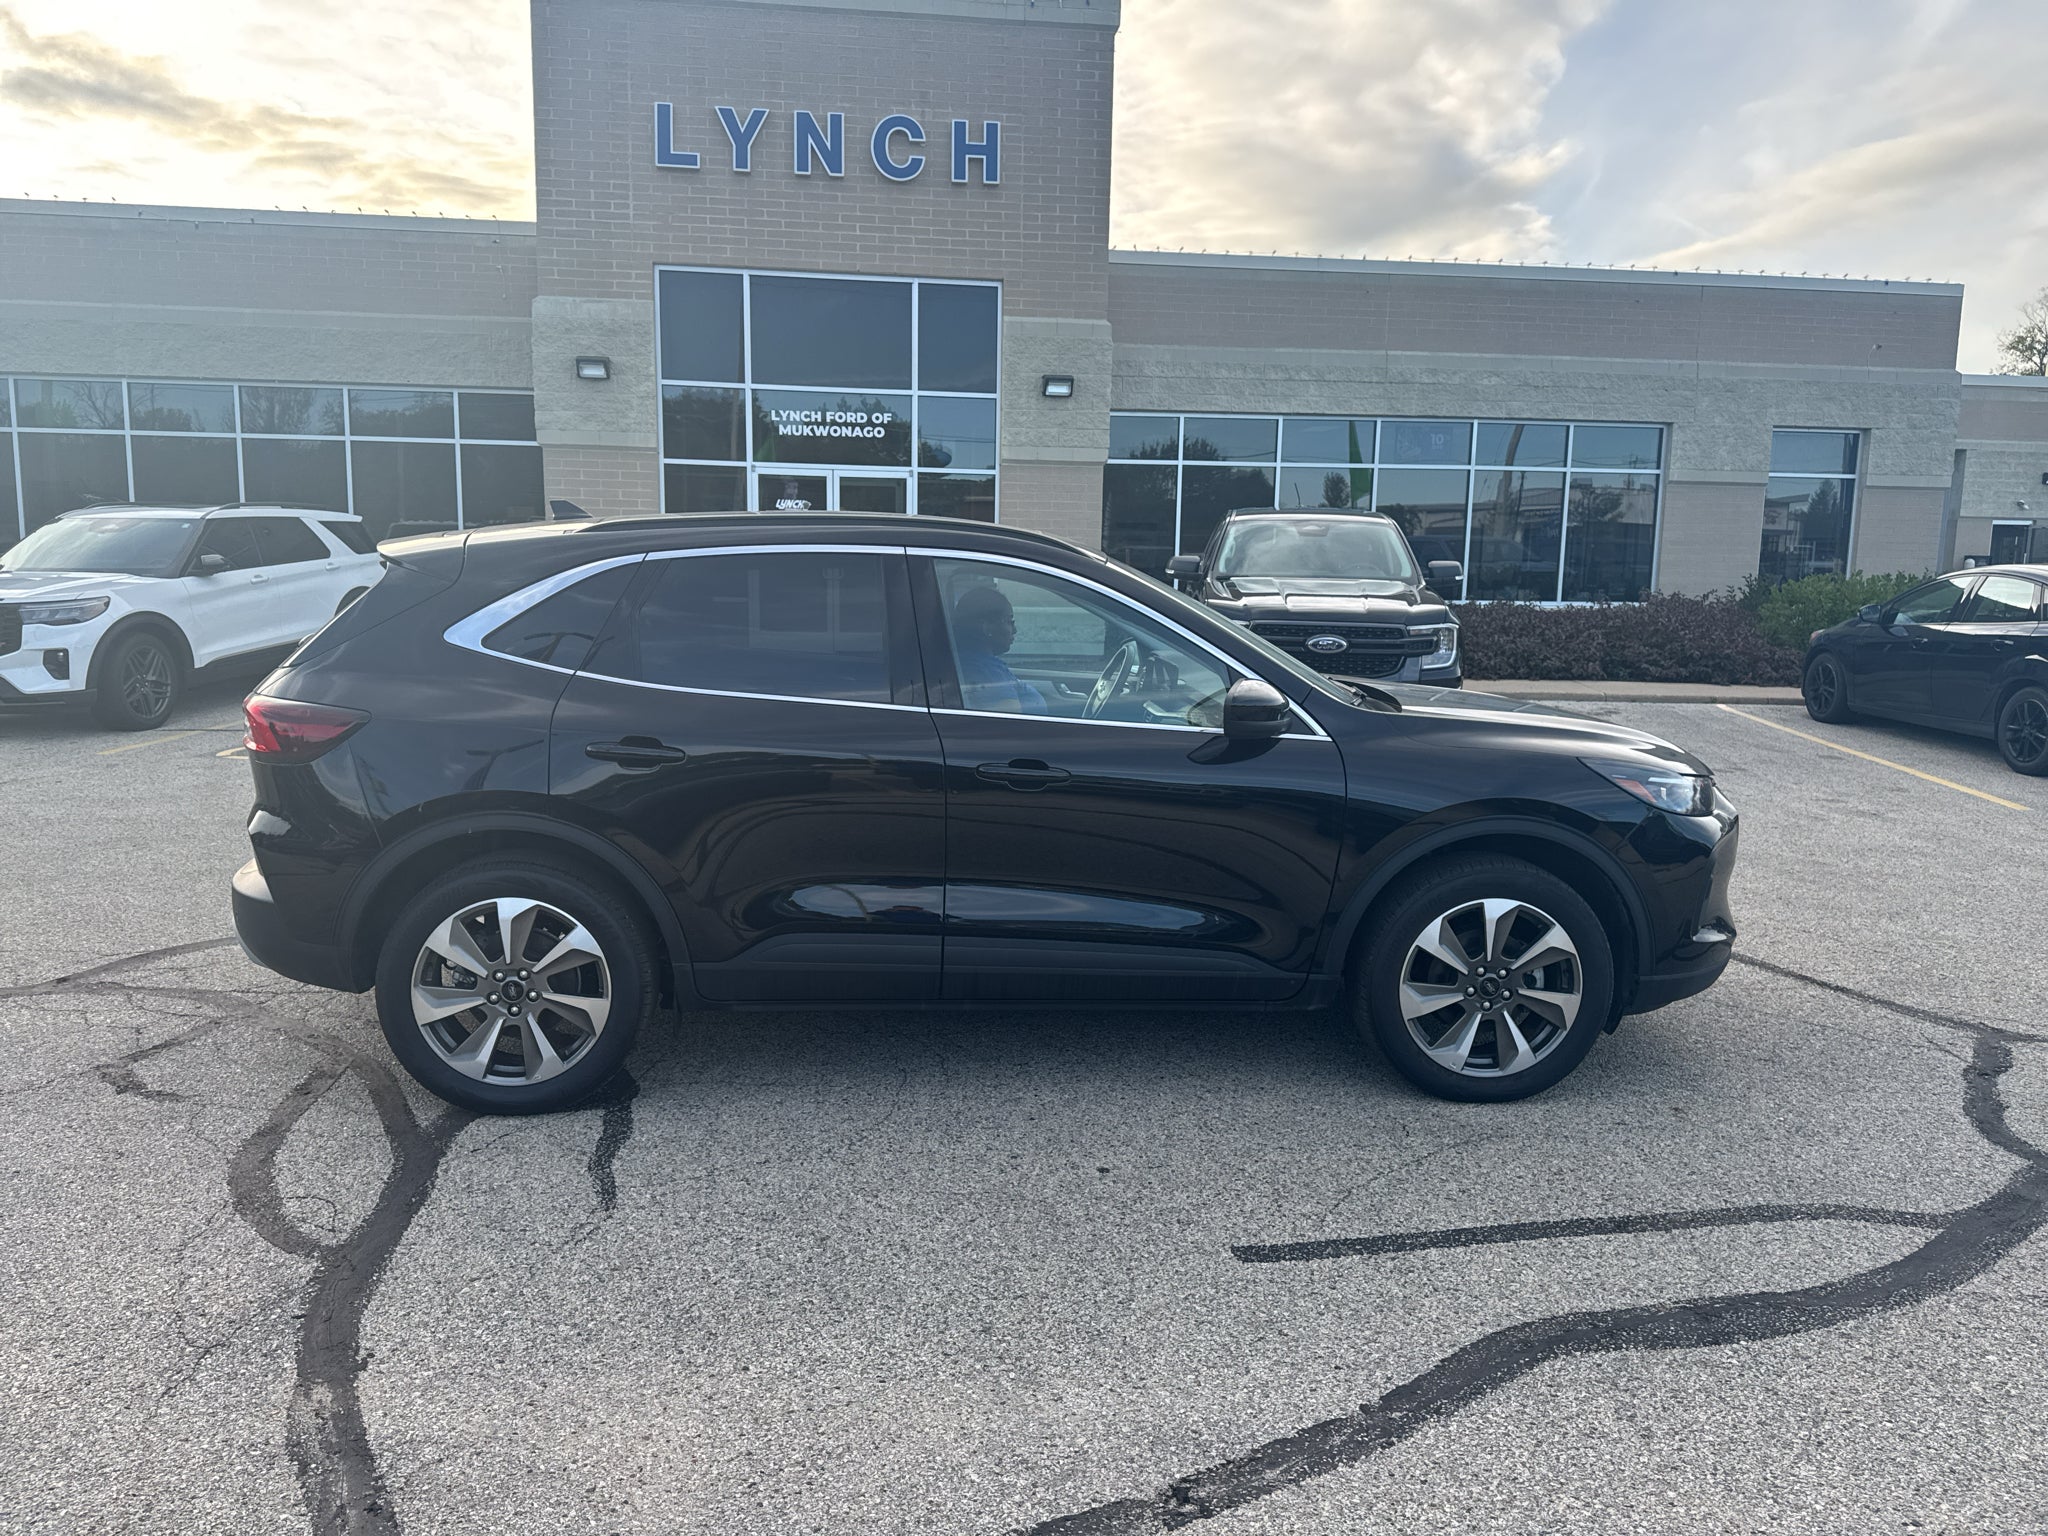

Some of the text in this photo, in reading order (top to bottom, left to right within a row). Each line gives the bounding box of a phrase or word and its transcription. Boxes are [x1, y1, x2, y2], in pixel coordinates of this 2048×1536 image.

[654, 102, 1000, 184] LYNCH
[770, 409, 893, 425] LYNCH FORD OF
[778, 424, 886, 439] MUKWONAGO
[1430, 433, 1445, 445] 10
[775, 498, 804, 510] LYNCH
